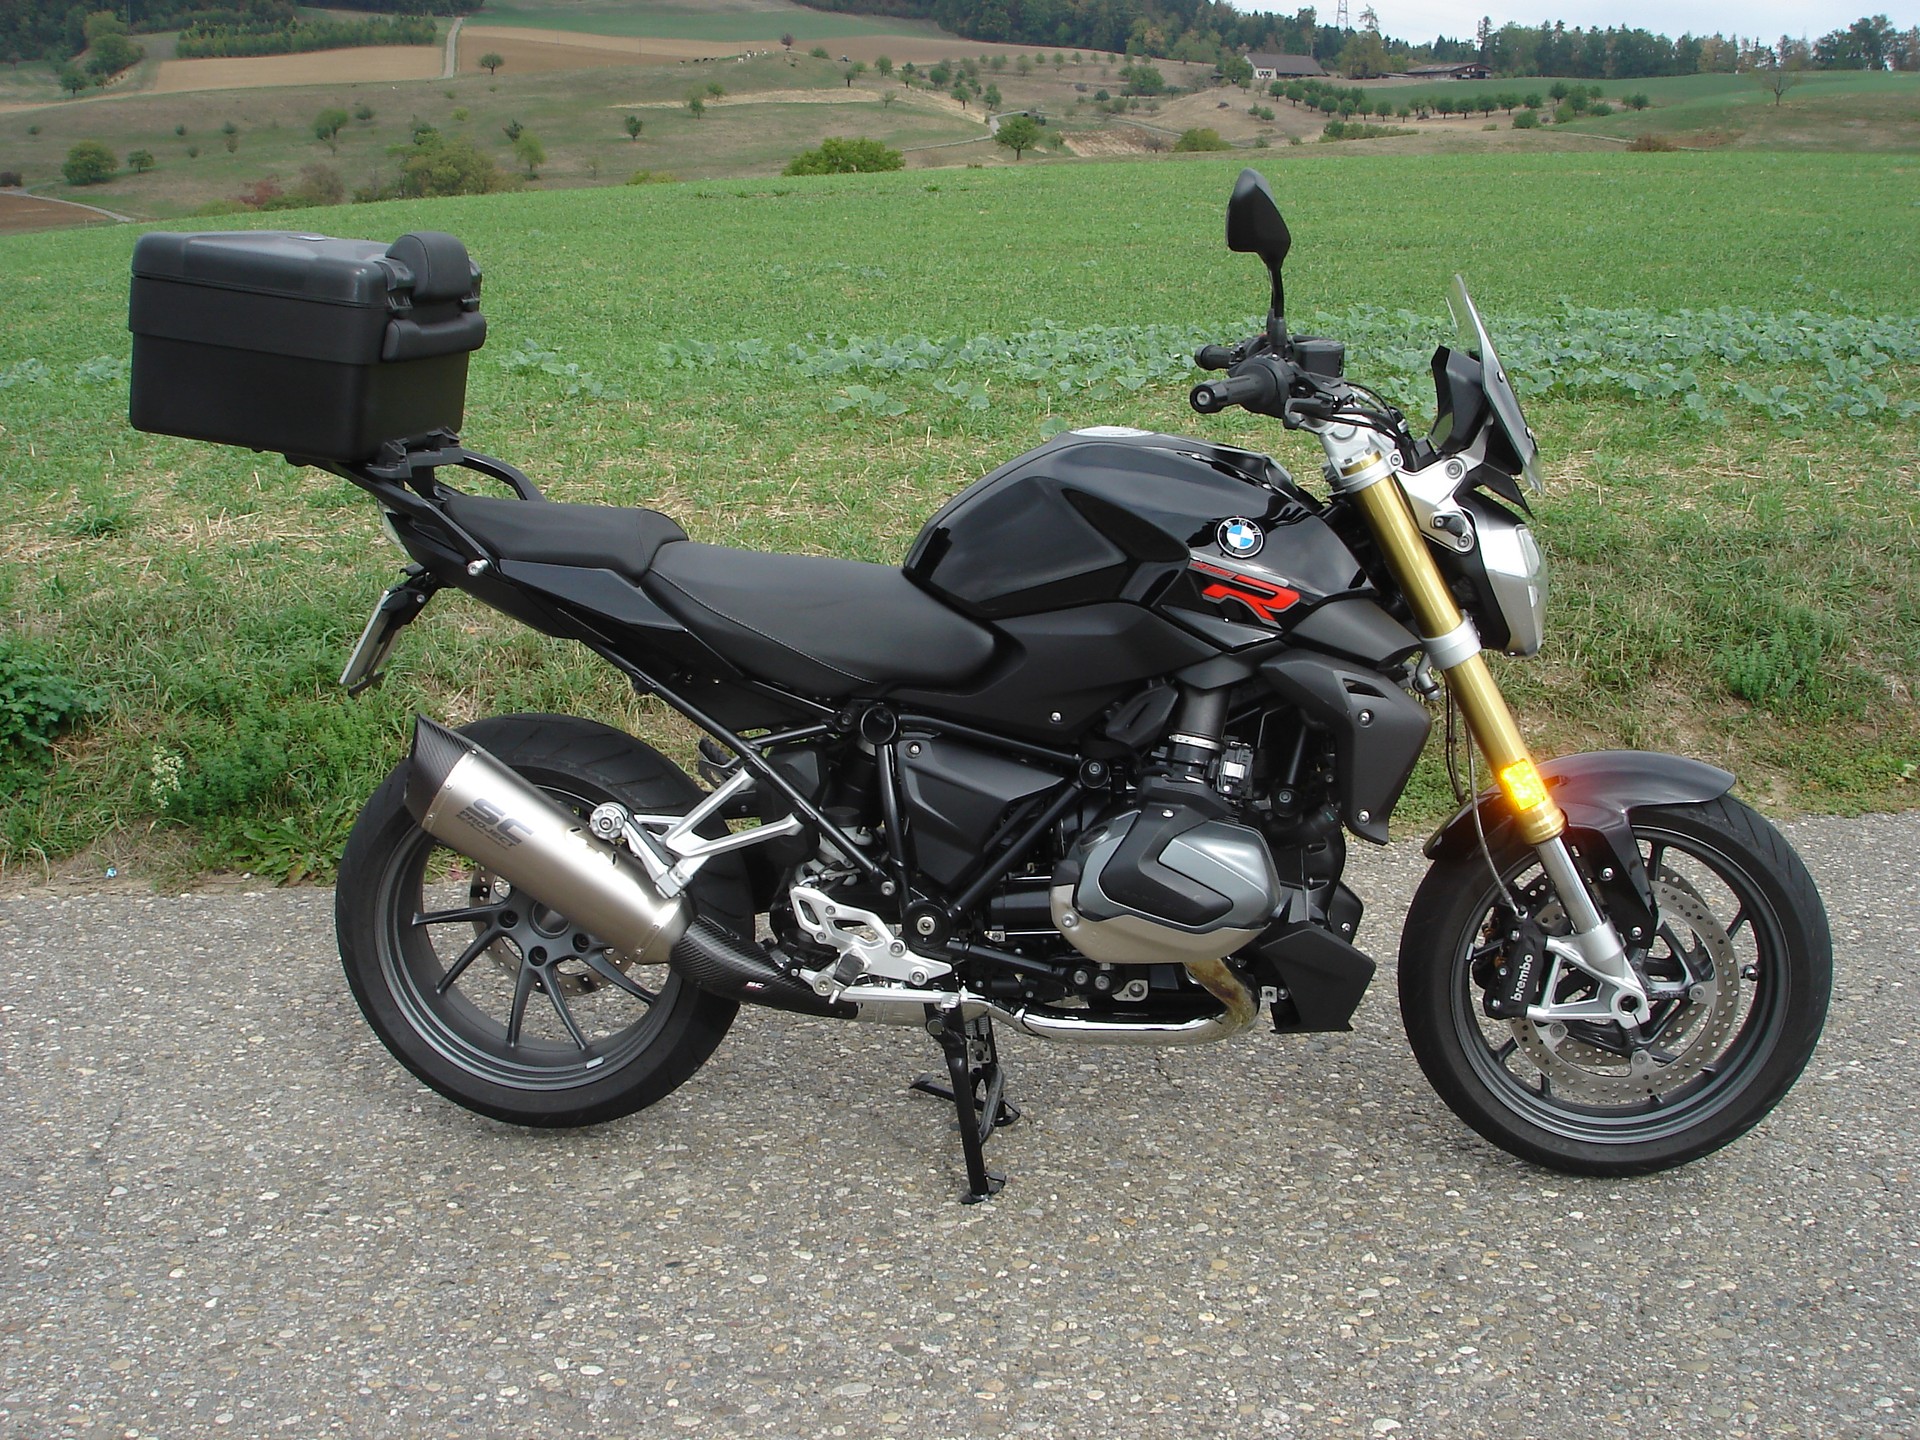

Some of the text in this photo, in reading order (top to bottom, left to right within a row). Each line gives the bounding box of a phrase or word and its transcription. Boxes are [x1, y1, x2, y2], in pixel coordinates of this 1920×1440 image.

[459, 810, 517, 847] PROJECT
[465, 798, 534, 844] SC
[1510, 954, 1534, 1002] brembo
